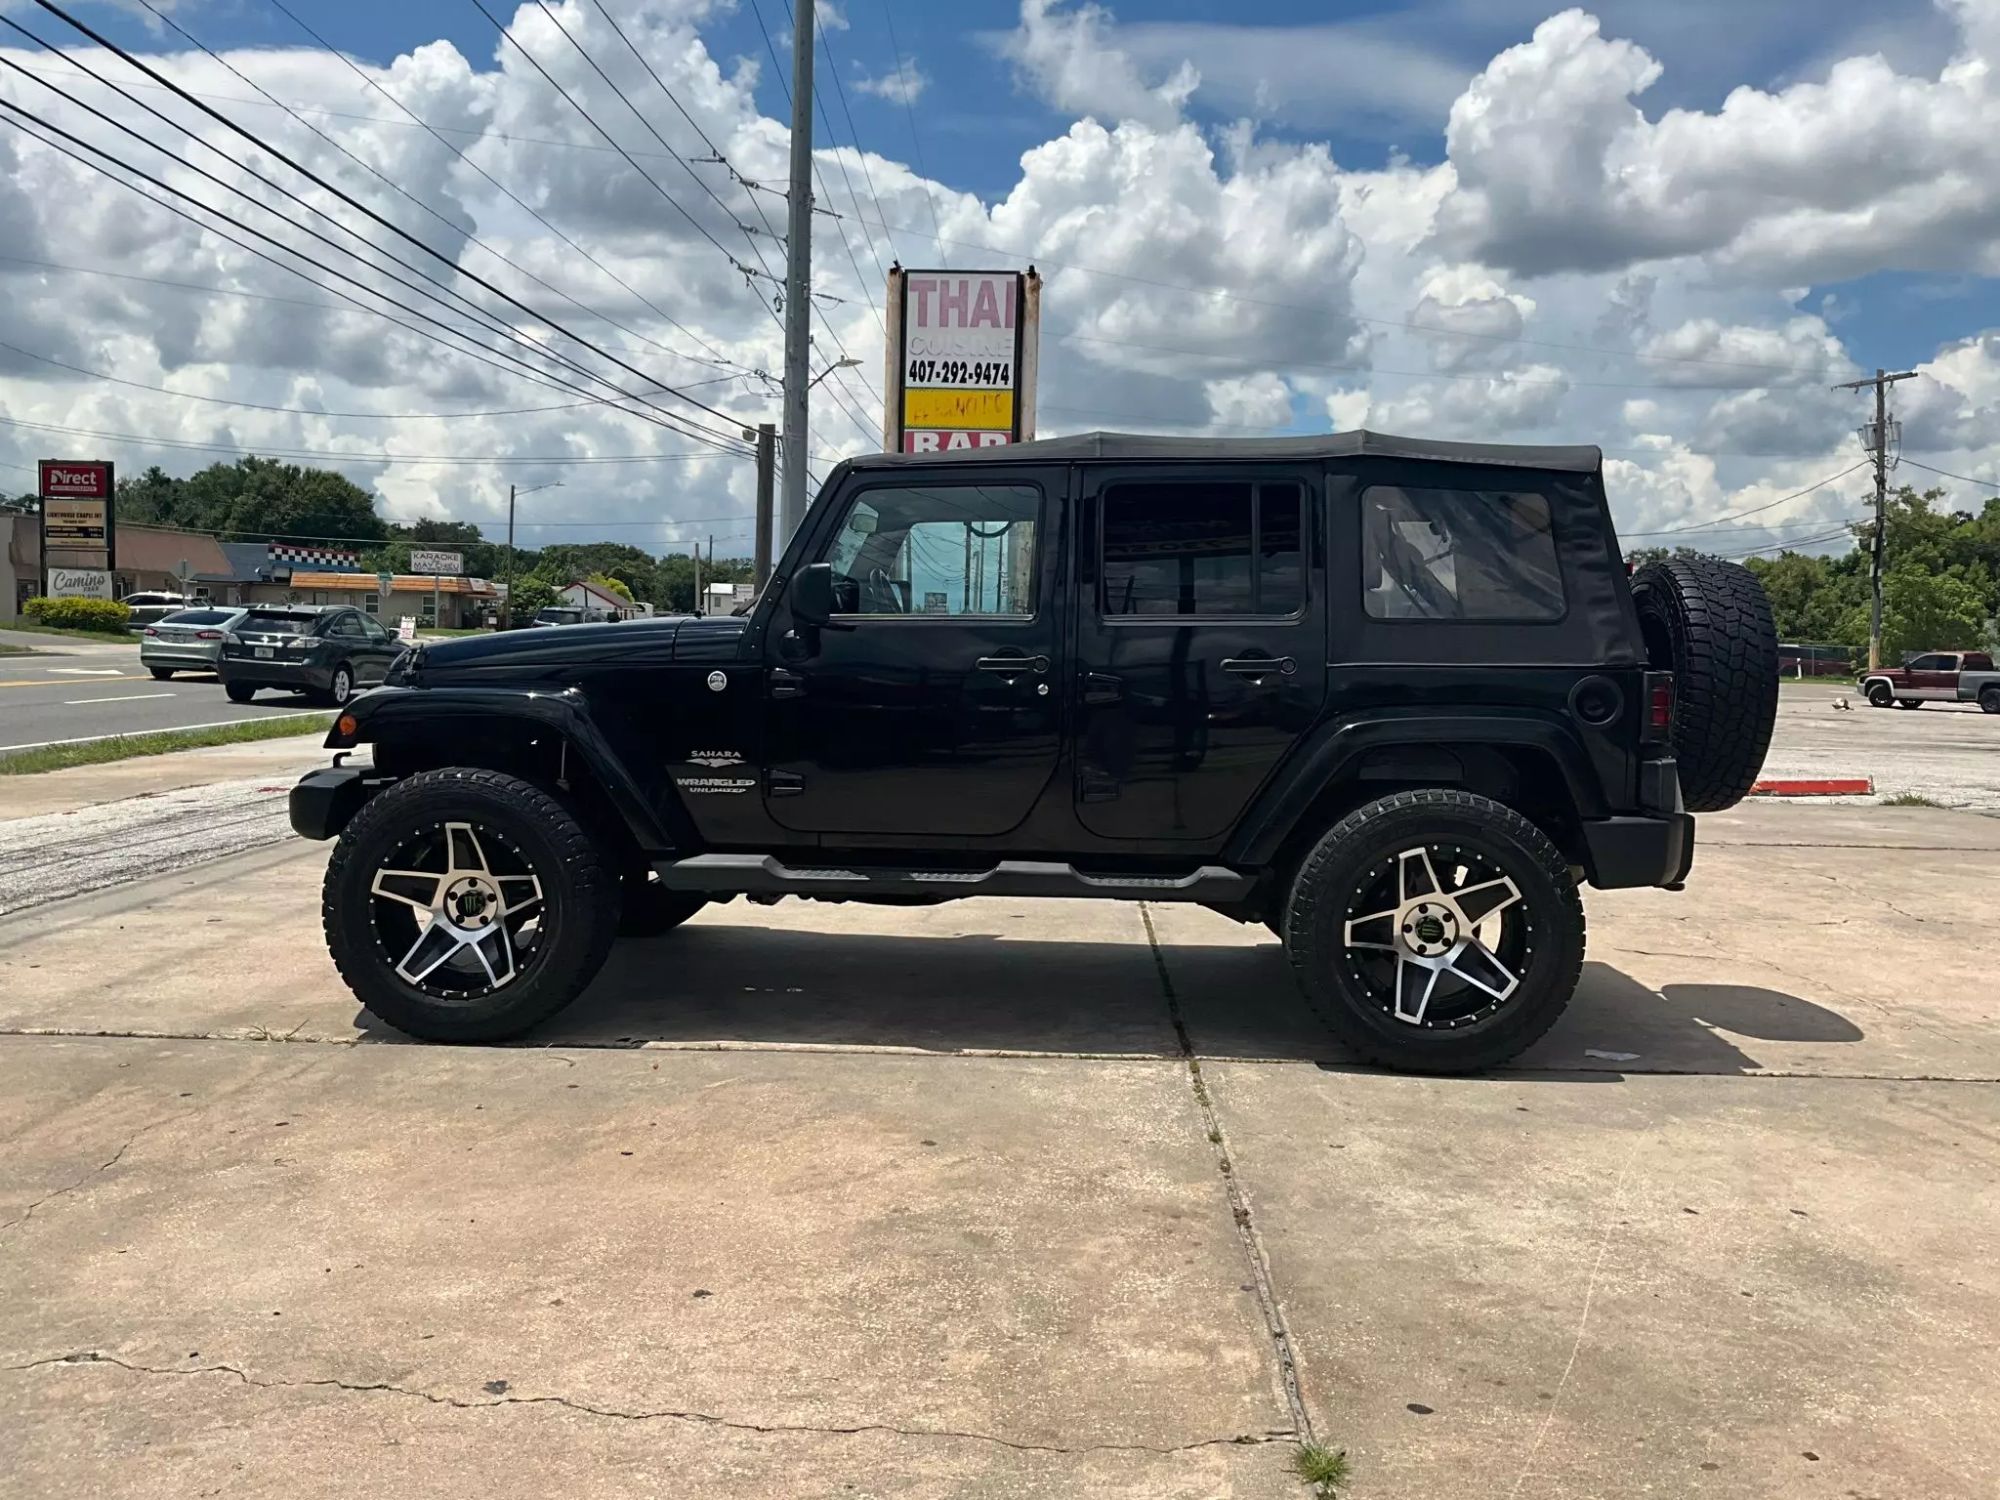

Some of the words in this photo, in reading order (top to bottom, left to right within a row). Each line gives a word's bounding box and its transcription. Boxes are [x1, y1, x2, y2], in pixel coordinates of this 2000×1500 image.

[908, 280, 1016, 328] THAI
[909, 360, 1010, 385] 407-292-9474
[51, 470, 97, 485] Direct
[414, 552, 459, 561] KARAOKE
[54, 571, 105, 591] Camino
[691, 750, 741, 758] SAHARA
